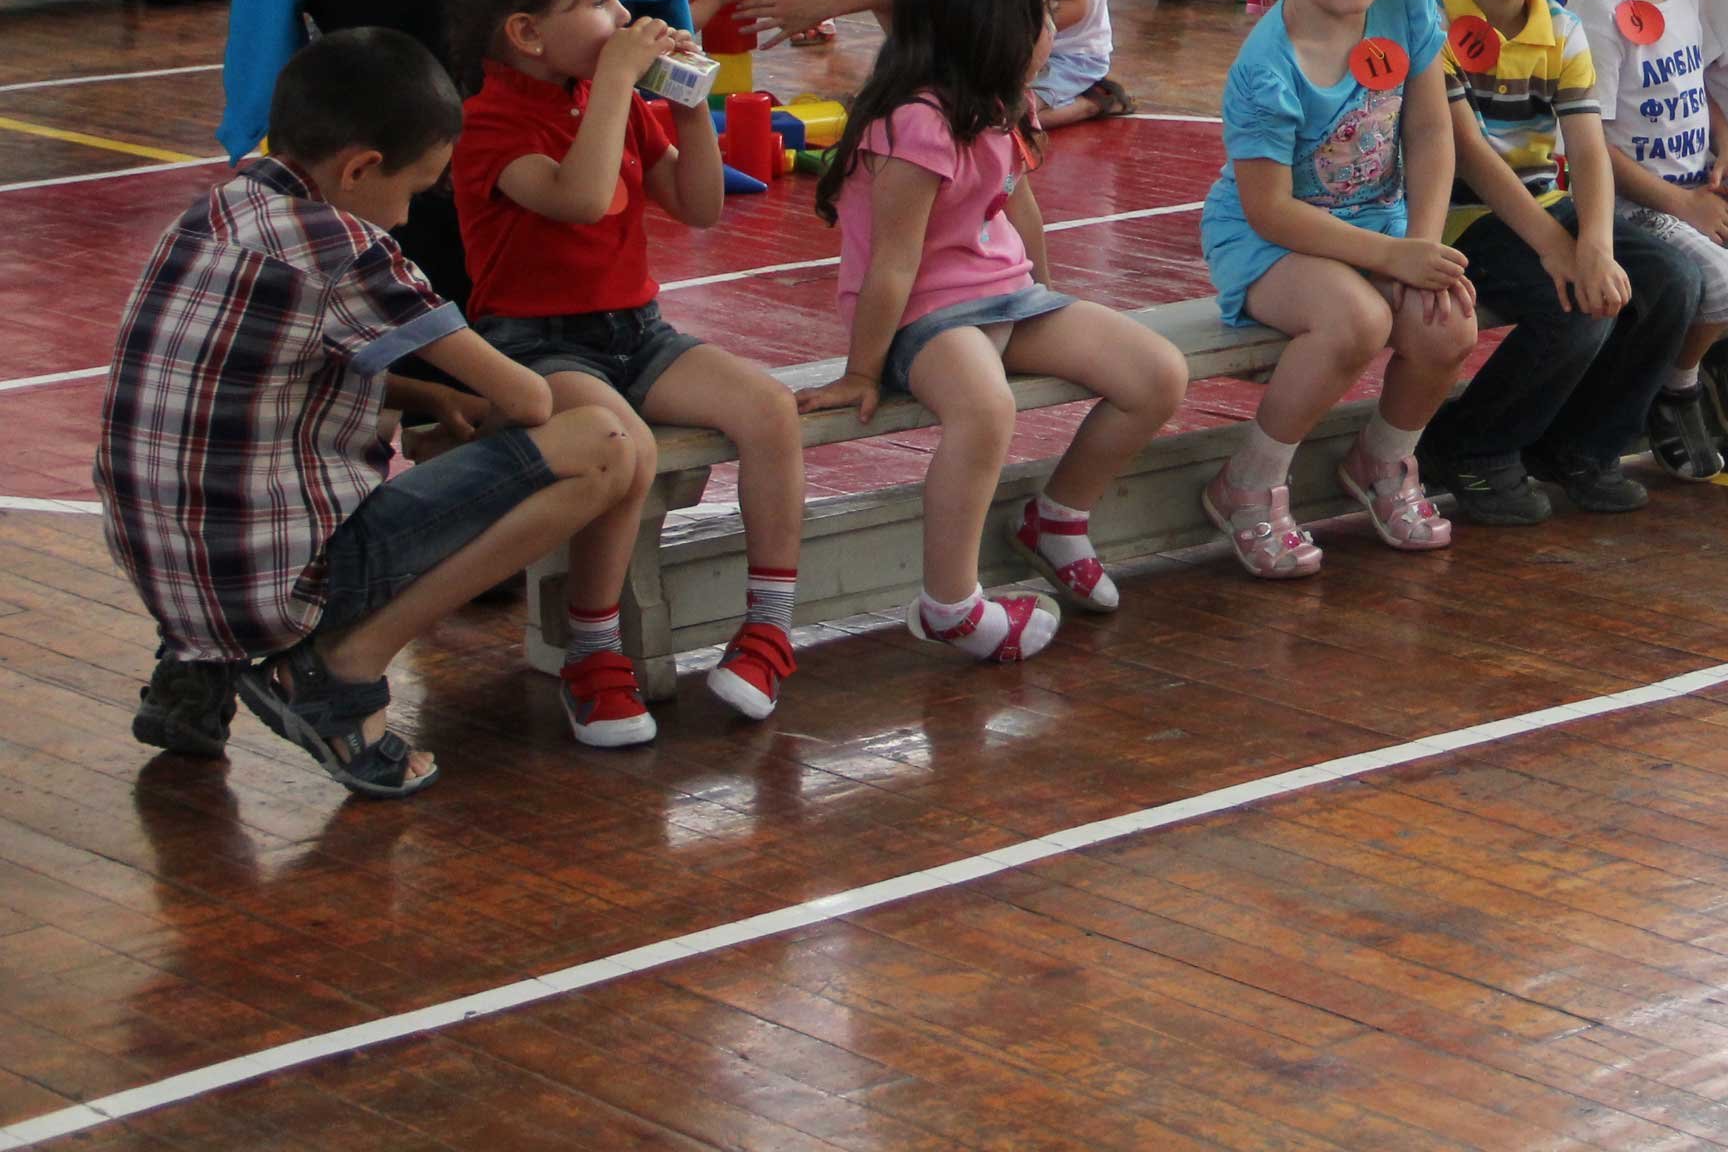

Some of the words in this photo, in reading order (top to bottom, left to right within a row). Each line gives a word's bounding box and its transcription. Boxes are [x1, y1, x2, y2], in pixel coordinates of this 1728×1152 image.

[1630, 15, 1644, 33] 9
[1458, 31, 1486, 59] 10
[1365, 51, 1392, 78] 11
[1631, 127, 1706, 162] ТАЧКИ
